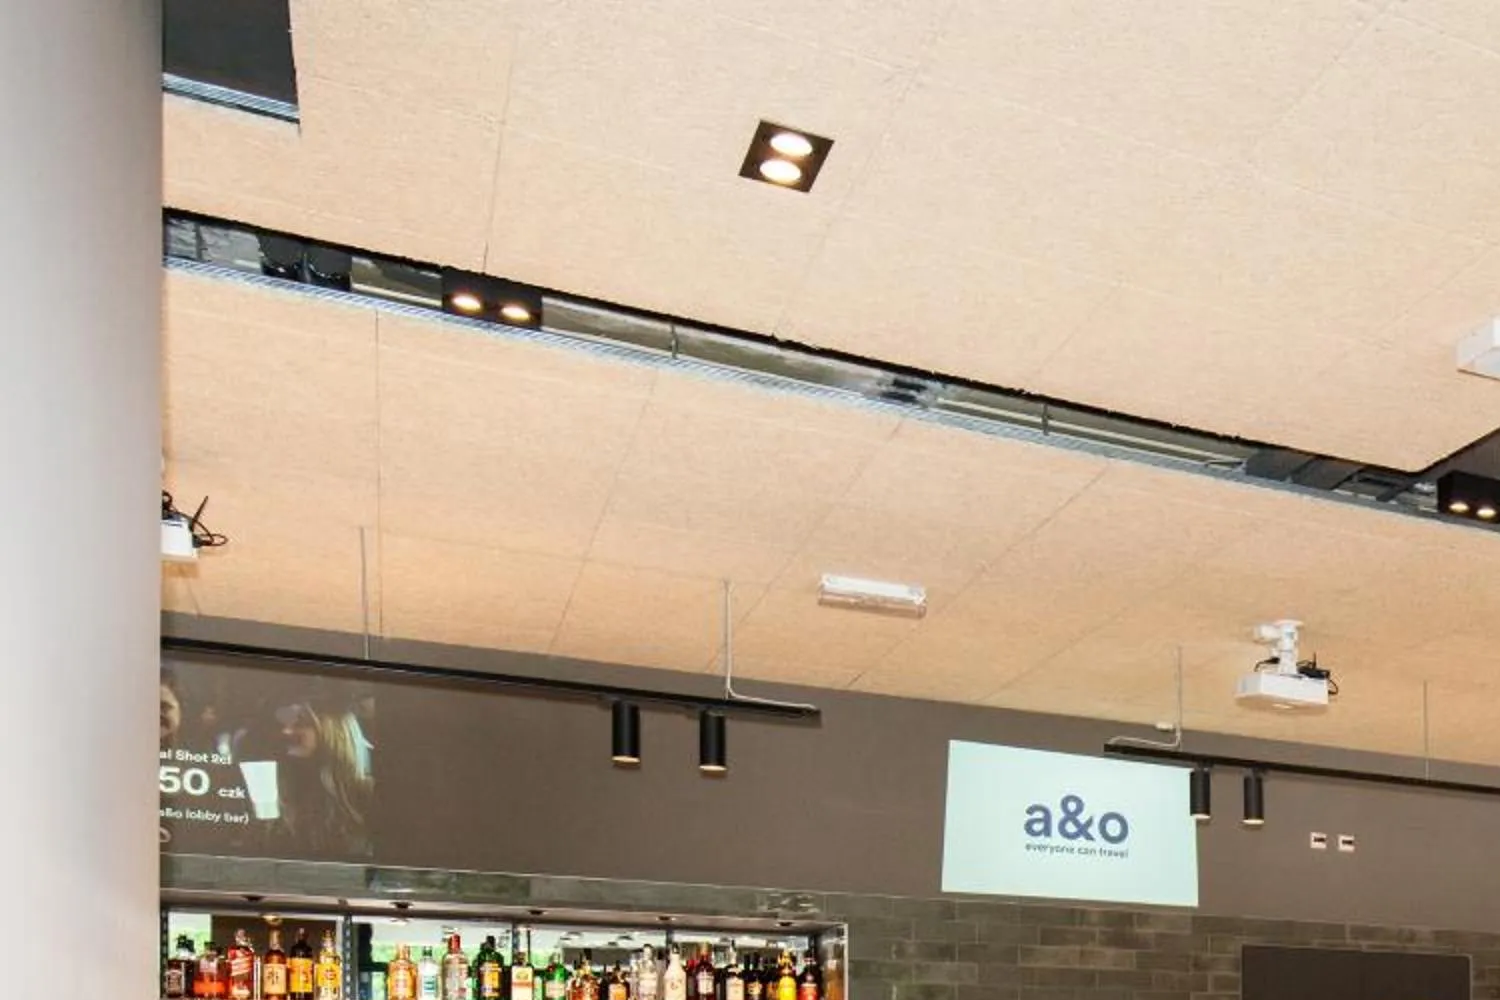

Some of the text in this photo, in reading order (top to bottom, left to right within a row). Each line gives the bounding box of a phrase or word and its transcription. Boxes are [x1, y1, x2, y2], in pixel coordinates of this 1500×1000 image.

[176, 750, 208, 763] Shot
[159, 766, 210, 796] 50
[186, 808, 220, 823] lobby
[1024, 794, 1129, 844] a&o
[1025, 844, 1129, 858] everyone can travel
